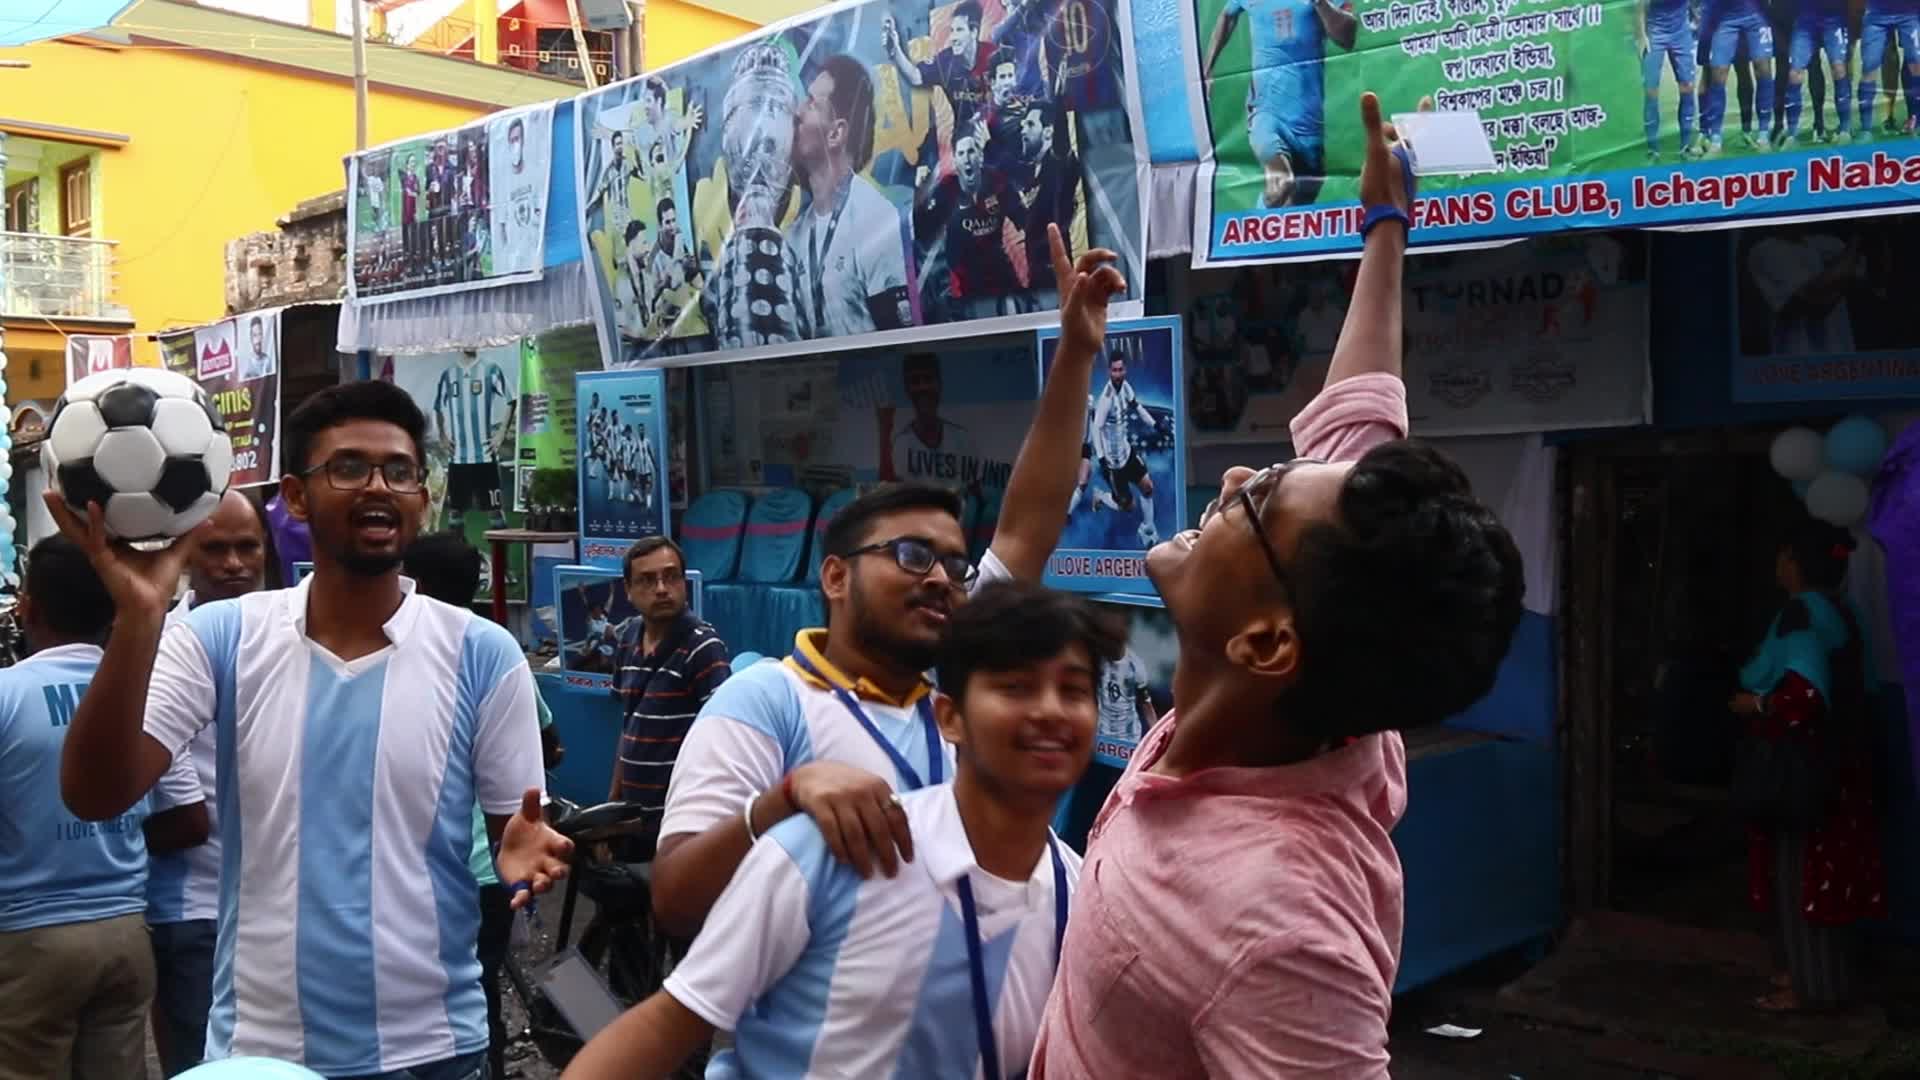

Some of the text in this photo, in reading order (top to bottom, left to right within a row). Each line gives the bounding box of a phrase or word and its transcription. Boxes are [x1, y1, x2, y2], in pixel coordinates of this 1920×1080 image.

[1403, 34, 1438, 55] আমরা
[1506, 13, 1547, 37] তোমার
[1411, 190, 1495, 227] FANS
[1506, 181, 1621, 218] CLUB,
[1633, 169, 1796, 207] Ichapur
[907, 448, 956, 479] LIVES
[1057, 556, 1091, 577] LOVE
[65, 820, 96, 841] LOVE
